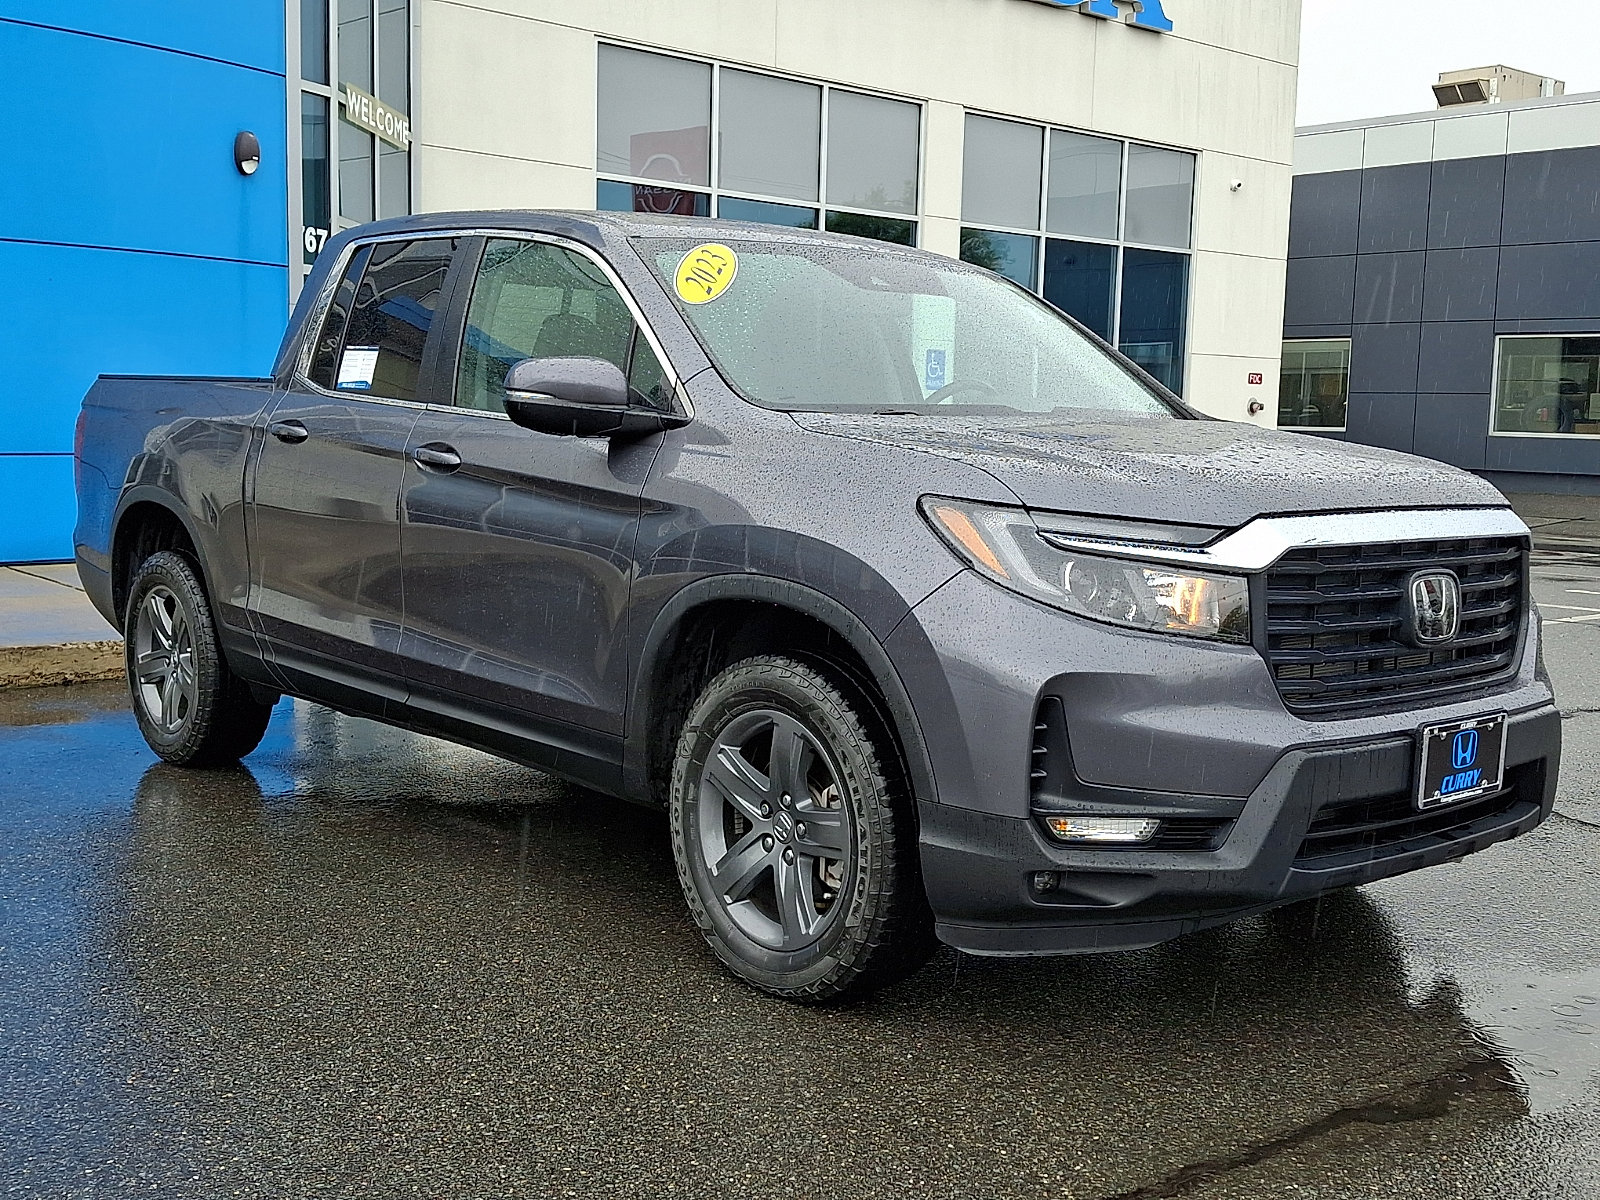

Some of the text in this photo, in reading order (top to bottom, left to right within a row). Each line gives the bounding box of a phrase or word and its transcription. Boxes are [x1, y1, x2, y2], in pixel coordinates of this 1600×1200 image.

[346, 87, 408, 146] WELCOME
[685, 249, 727, 295] 2023
[1441, 768, 1482, 794] CURRY
[818, 714, 868, 920] DESTINATION
